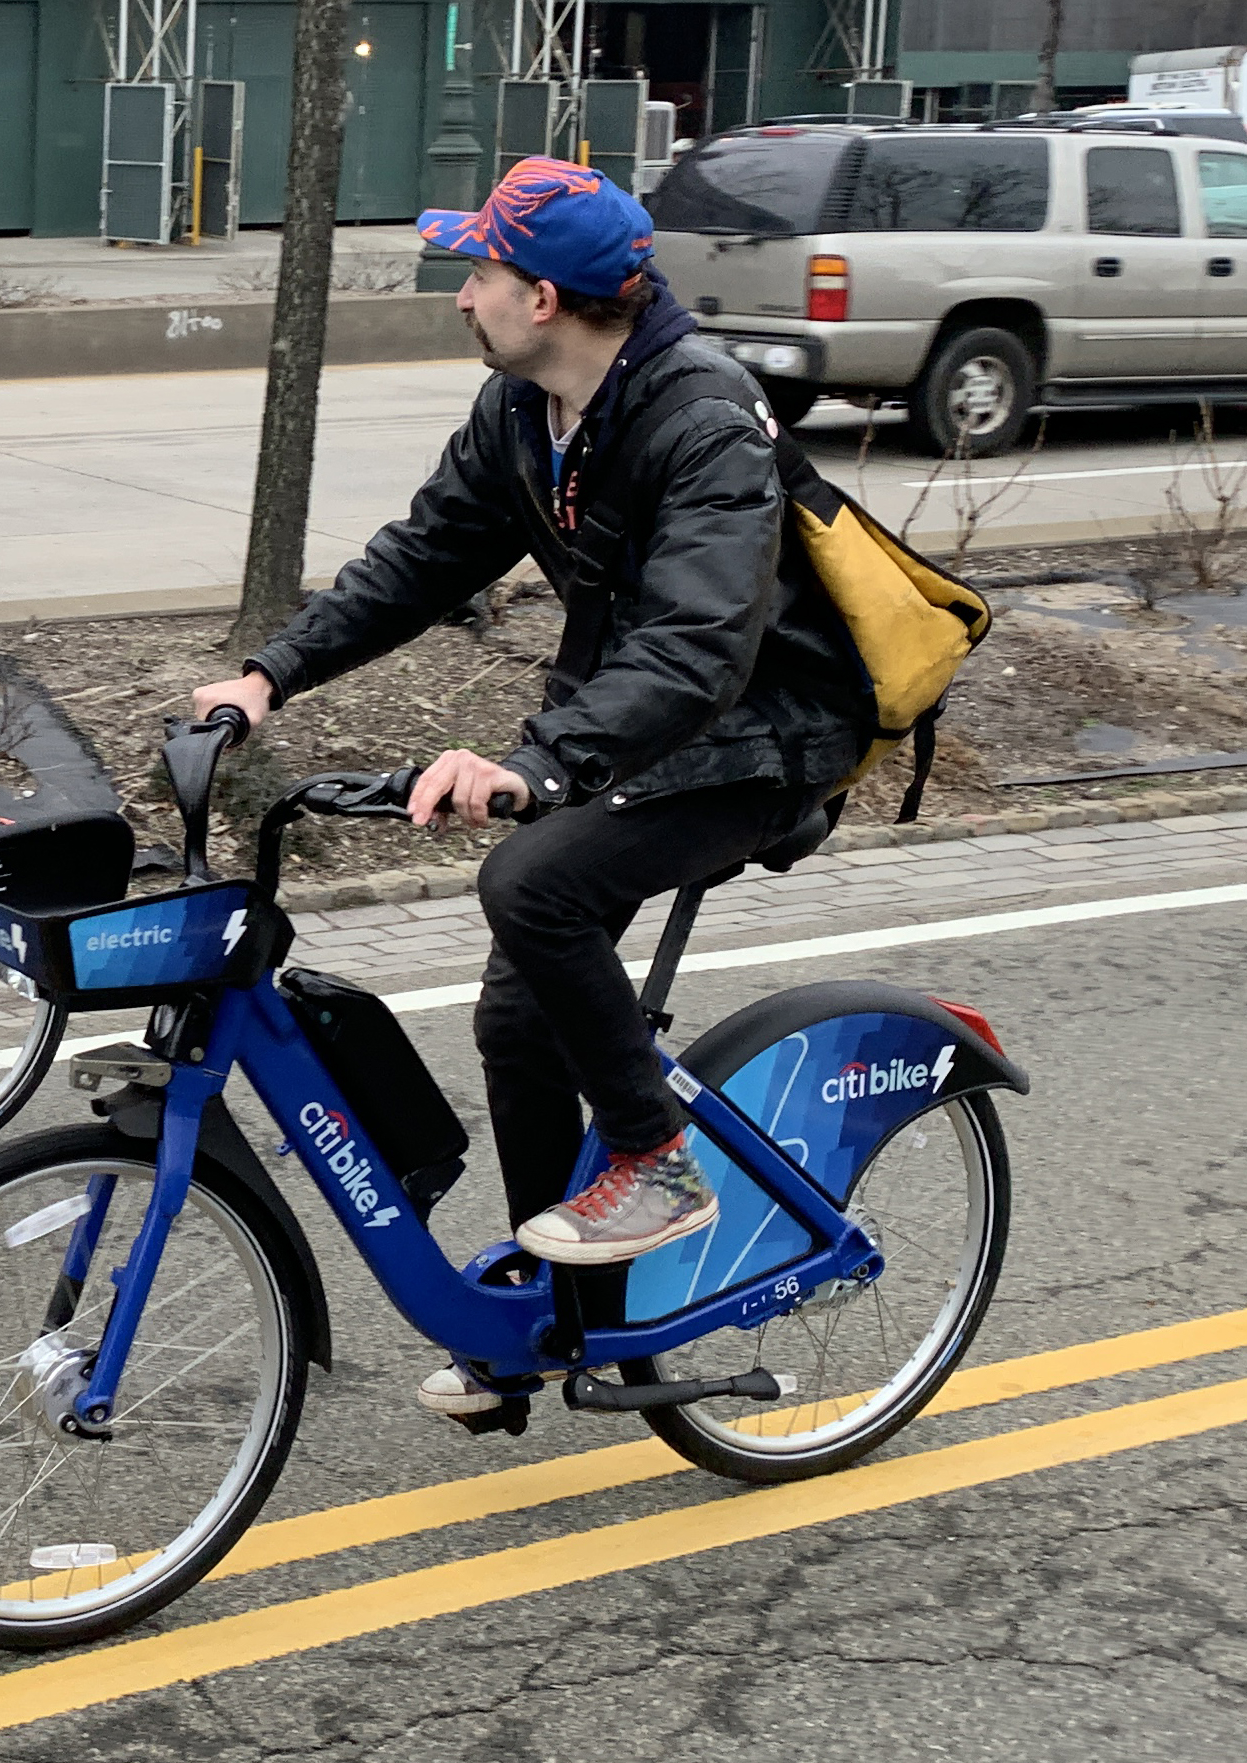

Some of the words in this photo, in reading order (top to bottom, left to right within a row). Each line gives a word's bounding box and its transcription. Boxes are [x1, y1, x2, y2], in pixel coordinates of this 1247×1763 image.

[86, 924, 173, 951] electric
[821, 1065, 867, 1104] citi
[869, 1058, 930, 1096] bike
[299, 1101, 345, 1155] citi
[326, 1139, 379, 1215] bike
